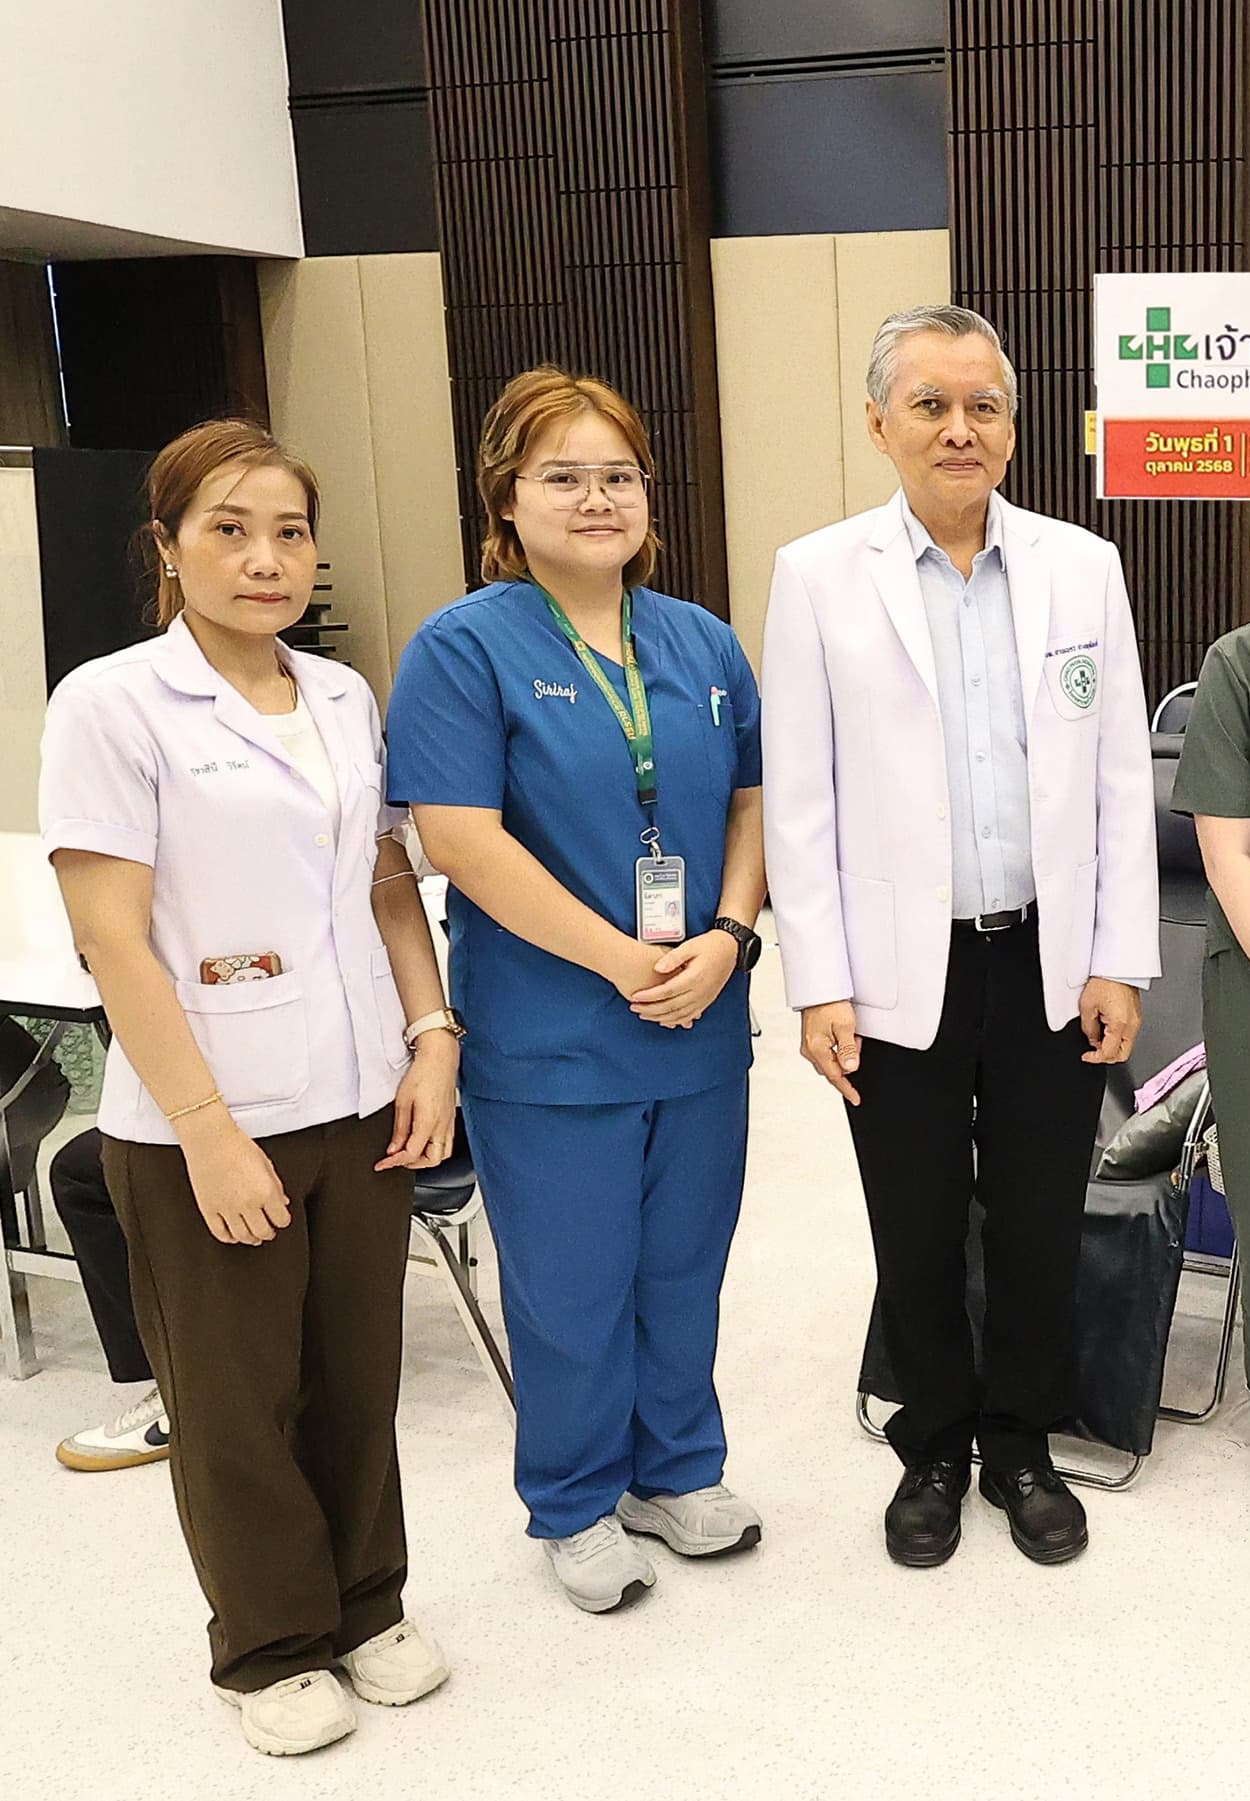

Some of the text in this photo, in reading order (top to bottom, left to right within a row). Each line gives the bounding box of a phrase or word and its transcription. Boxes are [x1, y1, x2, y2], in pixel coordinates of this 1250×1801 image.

[1145, 427, 1232, 458] วันพุธที่ 1
[1145, 459, 1233, 476] ตุลาคม 2568
[533, 679, 578, 704] Siriraj
